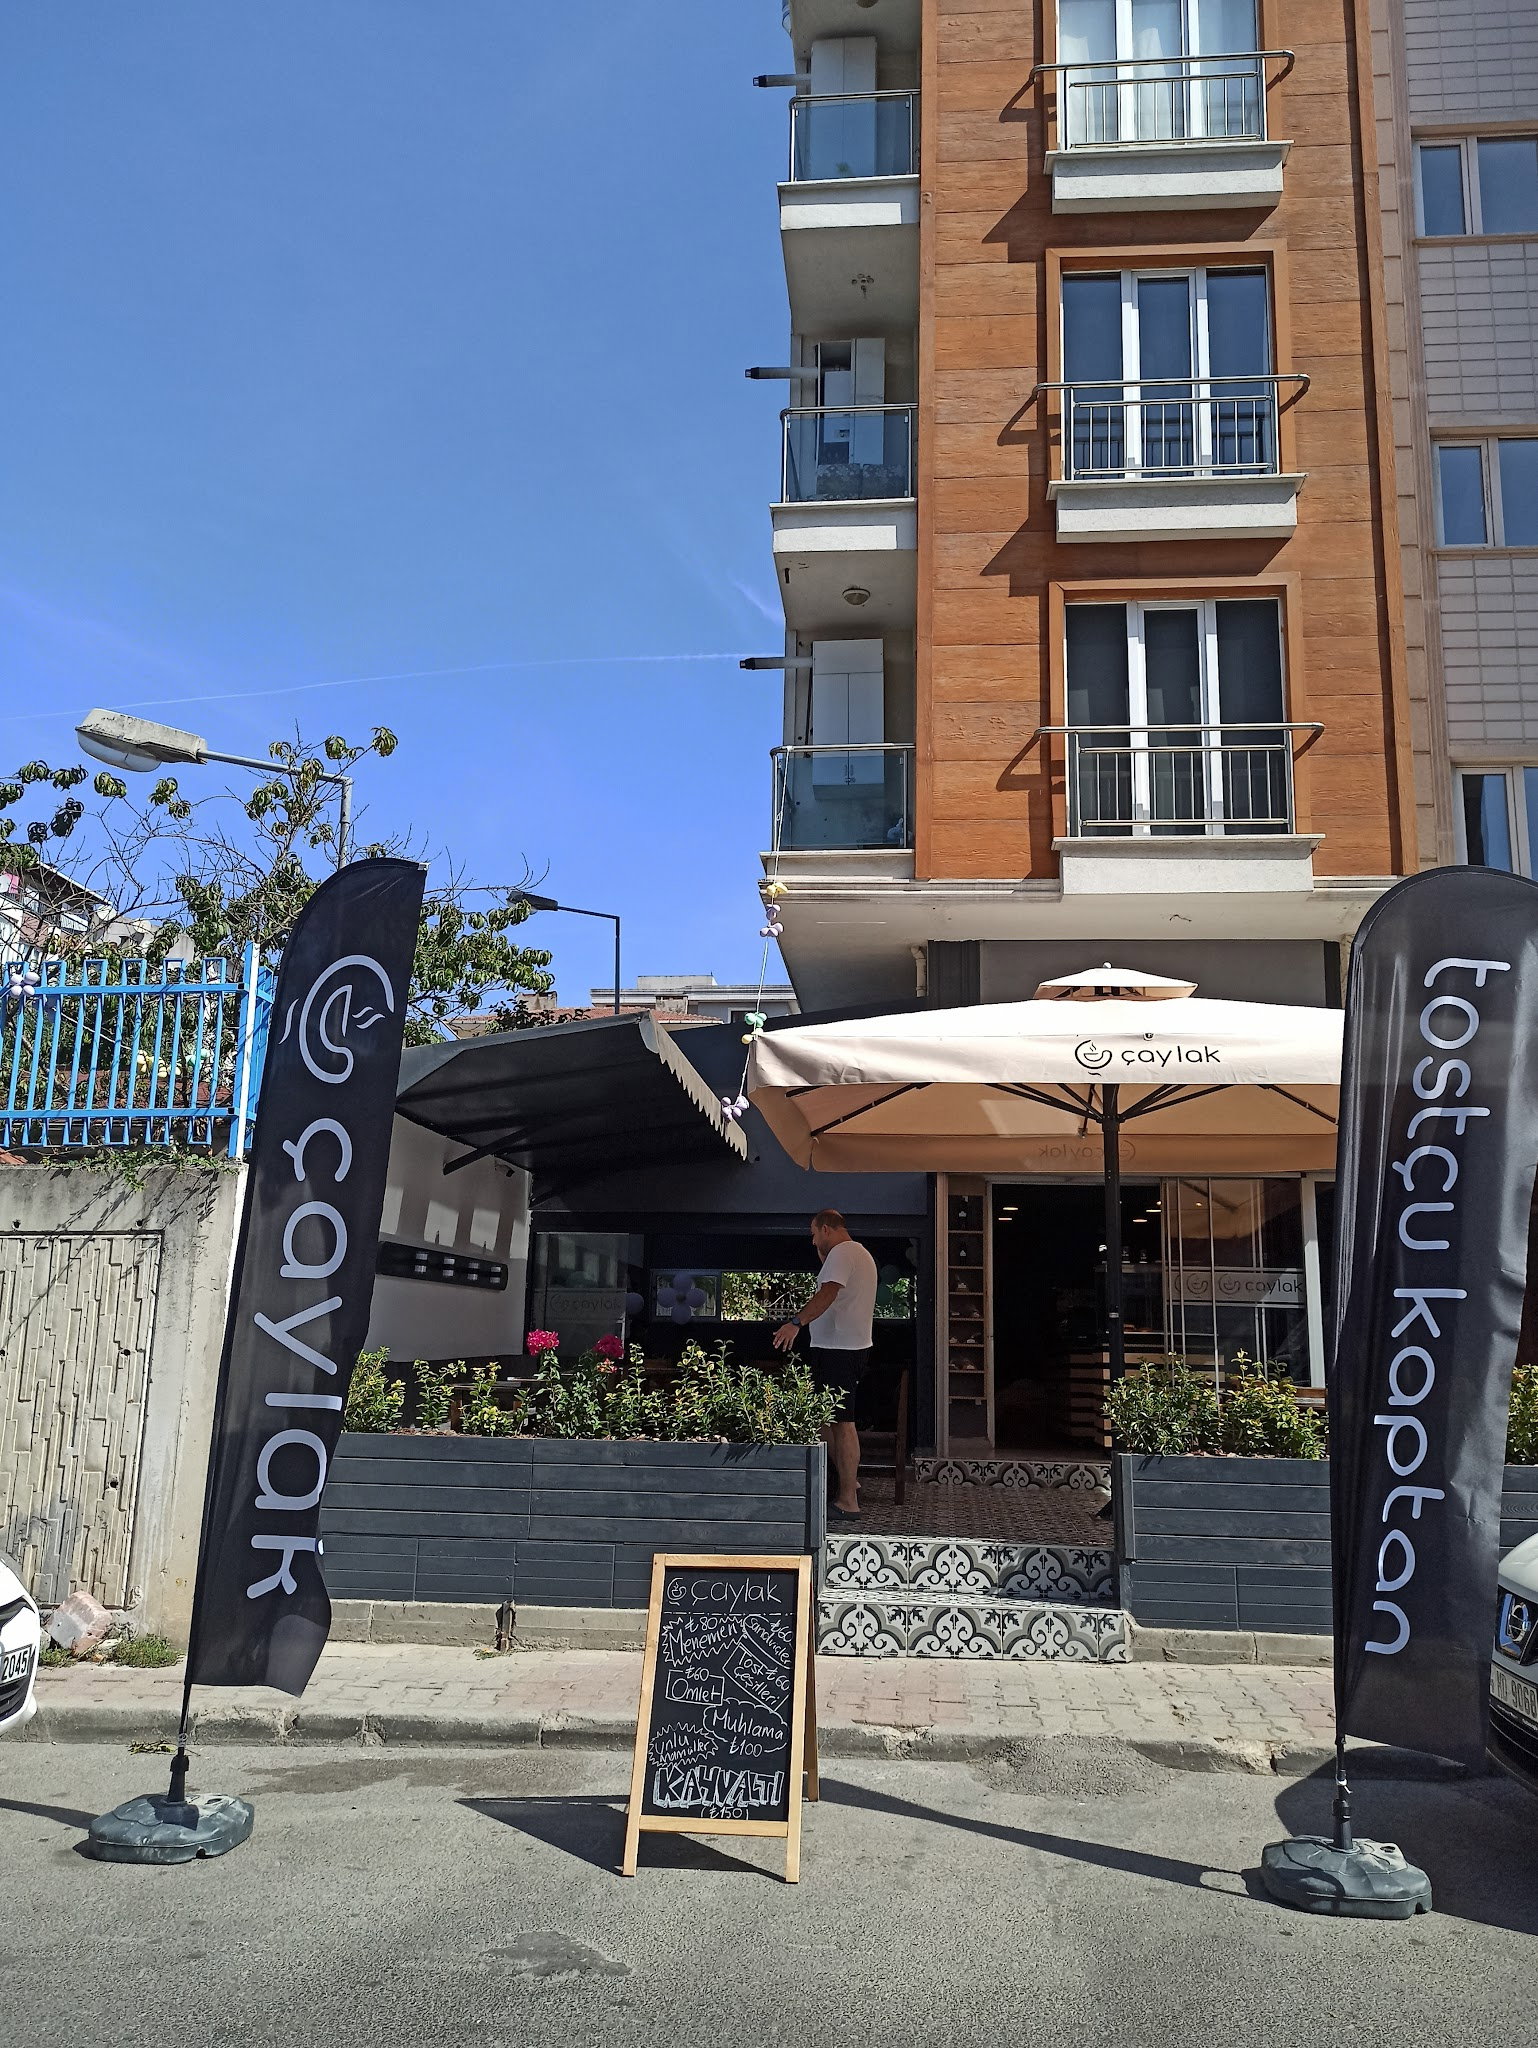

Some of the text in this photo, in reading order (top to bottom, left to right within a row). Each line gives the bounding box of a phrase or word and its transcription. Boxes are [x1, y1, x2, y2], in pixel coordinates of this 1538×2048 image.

[1121, 1045, 1221, 1067] çaylak
[1365, 957, 1510, 1655] tostçu kaptan
[246, 1117, 353, 1600] çaylak
[669, 1622, 738, 1660] Menemen
[1, 1650, 29, 1681] 2045
[671, 1678, 721, 1702] Omlet
[712, 1708, 784, 1740] Muhlama
